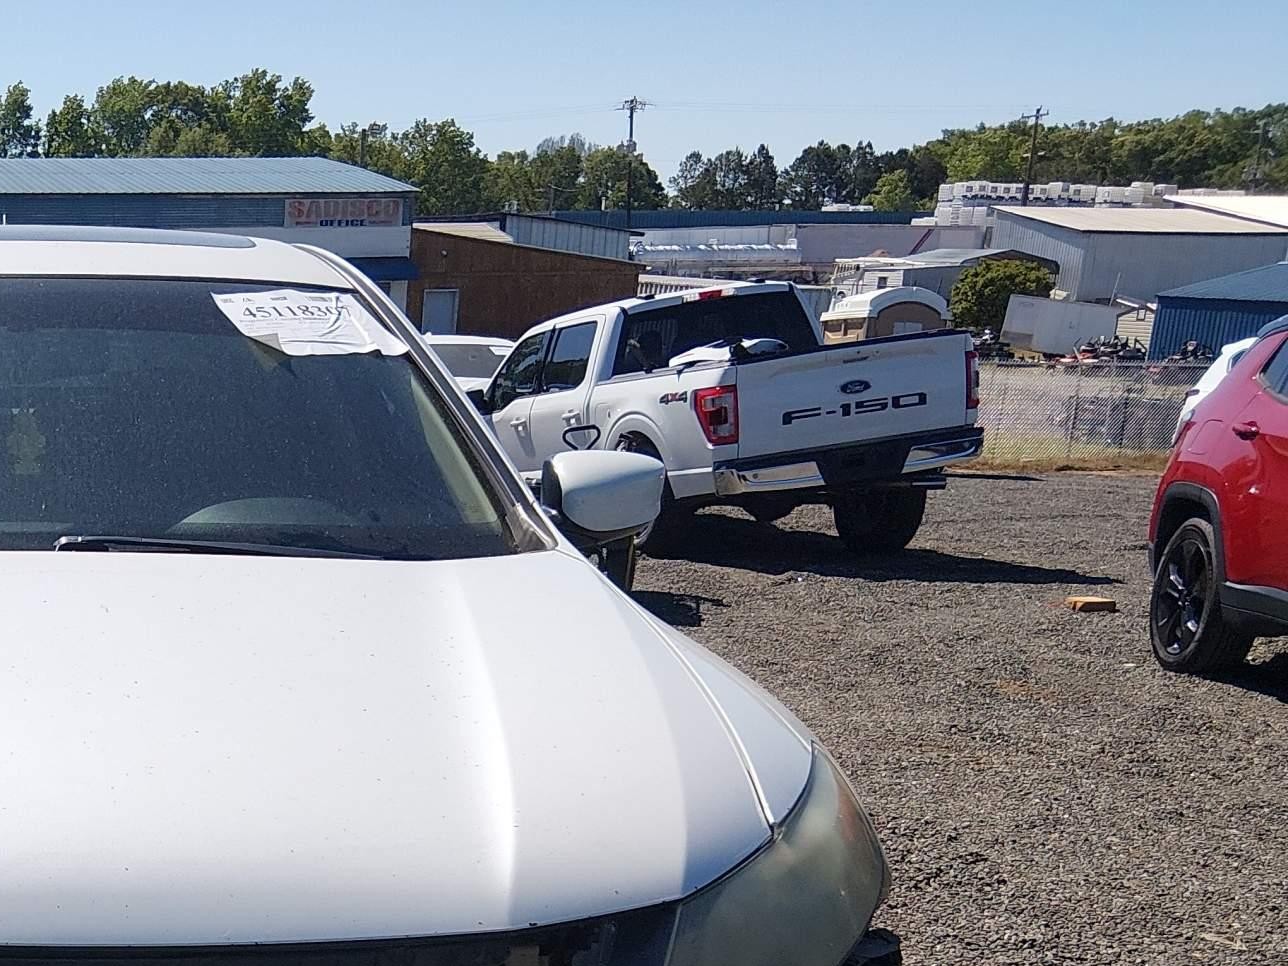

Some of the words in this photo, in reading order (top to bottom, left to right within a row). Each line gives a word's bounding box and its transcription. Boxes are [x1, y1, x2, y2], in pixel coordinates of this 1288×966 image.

[287, 200, 400, 218] SADISCO
[319, 219, 368, 227] OFFICE
[782, 392, 927, 425] F-150
